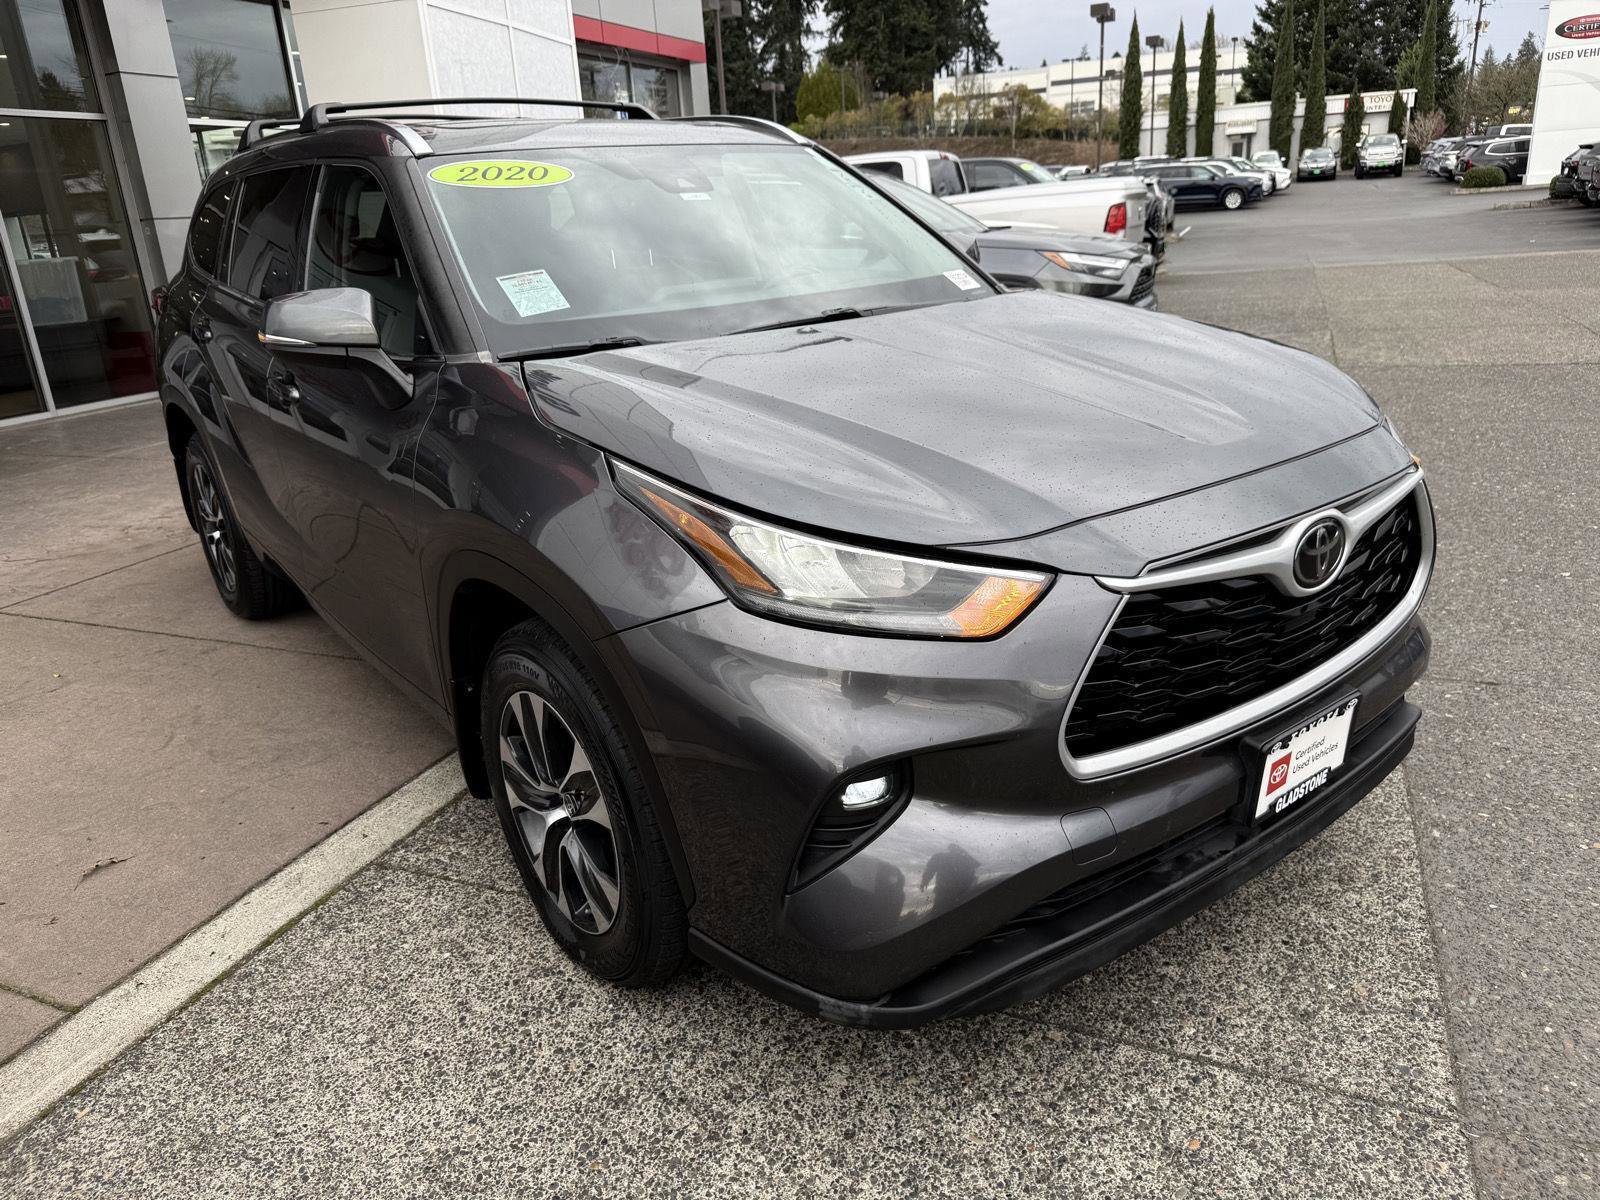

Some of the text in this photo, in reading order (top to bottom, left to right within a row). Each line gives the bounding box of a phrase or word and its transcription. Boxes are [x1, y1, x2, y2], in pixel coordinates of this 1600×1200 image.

[1547, 47, 1600, 61] USED VEHI
[1370, 95, 1392, 104] TOYO
[457, 165, 549, 182] 2020
[1292, 742, 1339, 774] Used Vehicles
[1295, 735, 1326, 760] Certified
[1275, 768, 1329, 813] GLADSTONE
